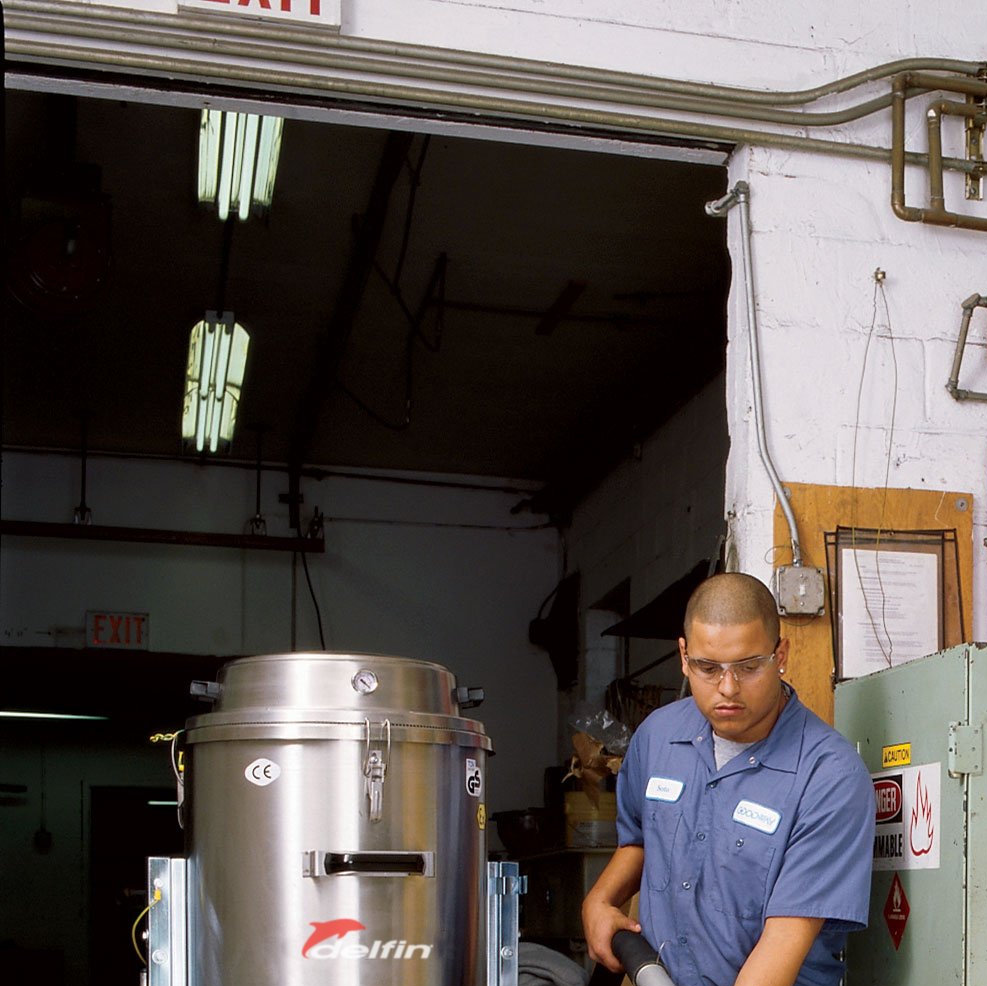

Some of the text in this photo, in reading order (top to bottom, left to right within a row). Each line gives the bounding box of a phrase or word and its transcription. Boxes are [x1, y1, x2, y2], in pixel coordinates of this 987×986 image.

[93, 615, 143, 645] EXIT
[888, 749, 909, 762] CAUTION
[876, 787, 896, 813] NGER
[873, 834, 902, 858] MABLE
[310, 940, 431, 959] delfin
